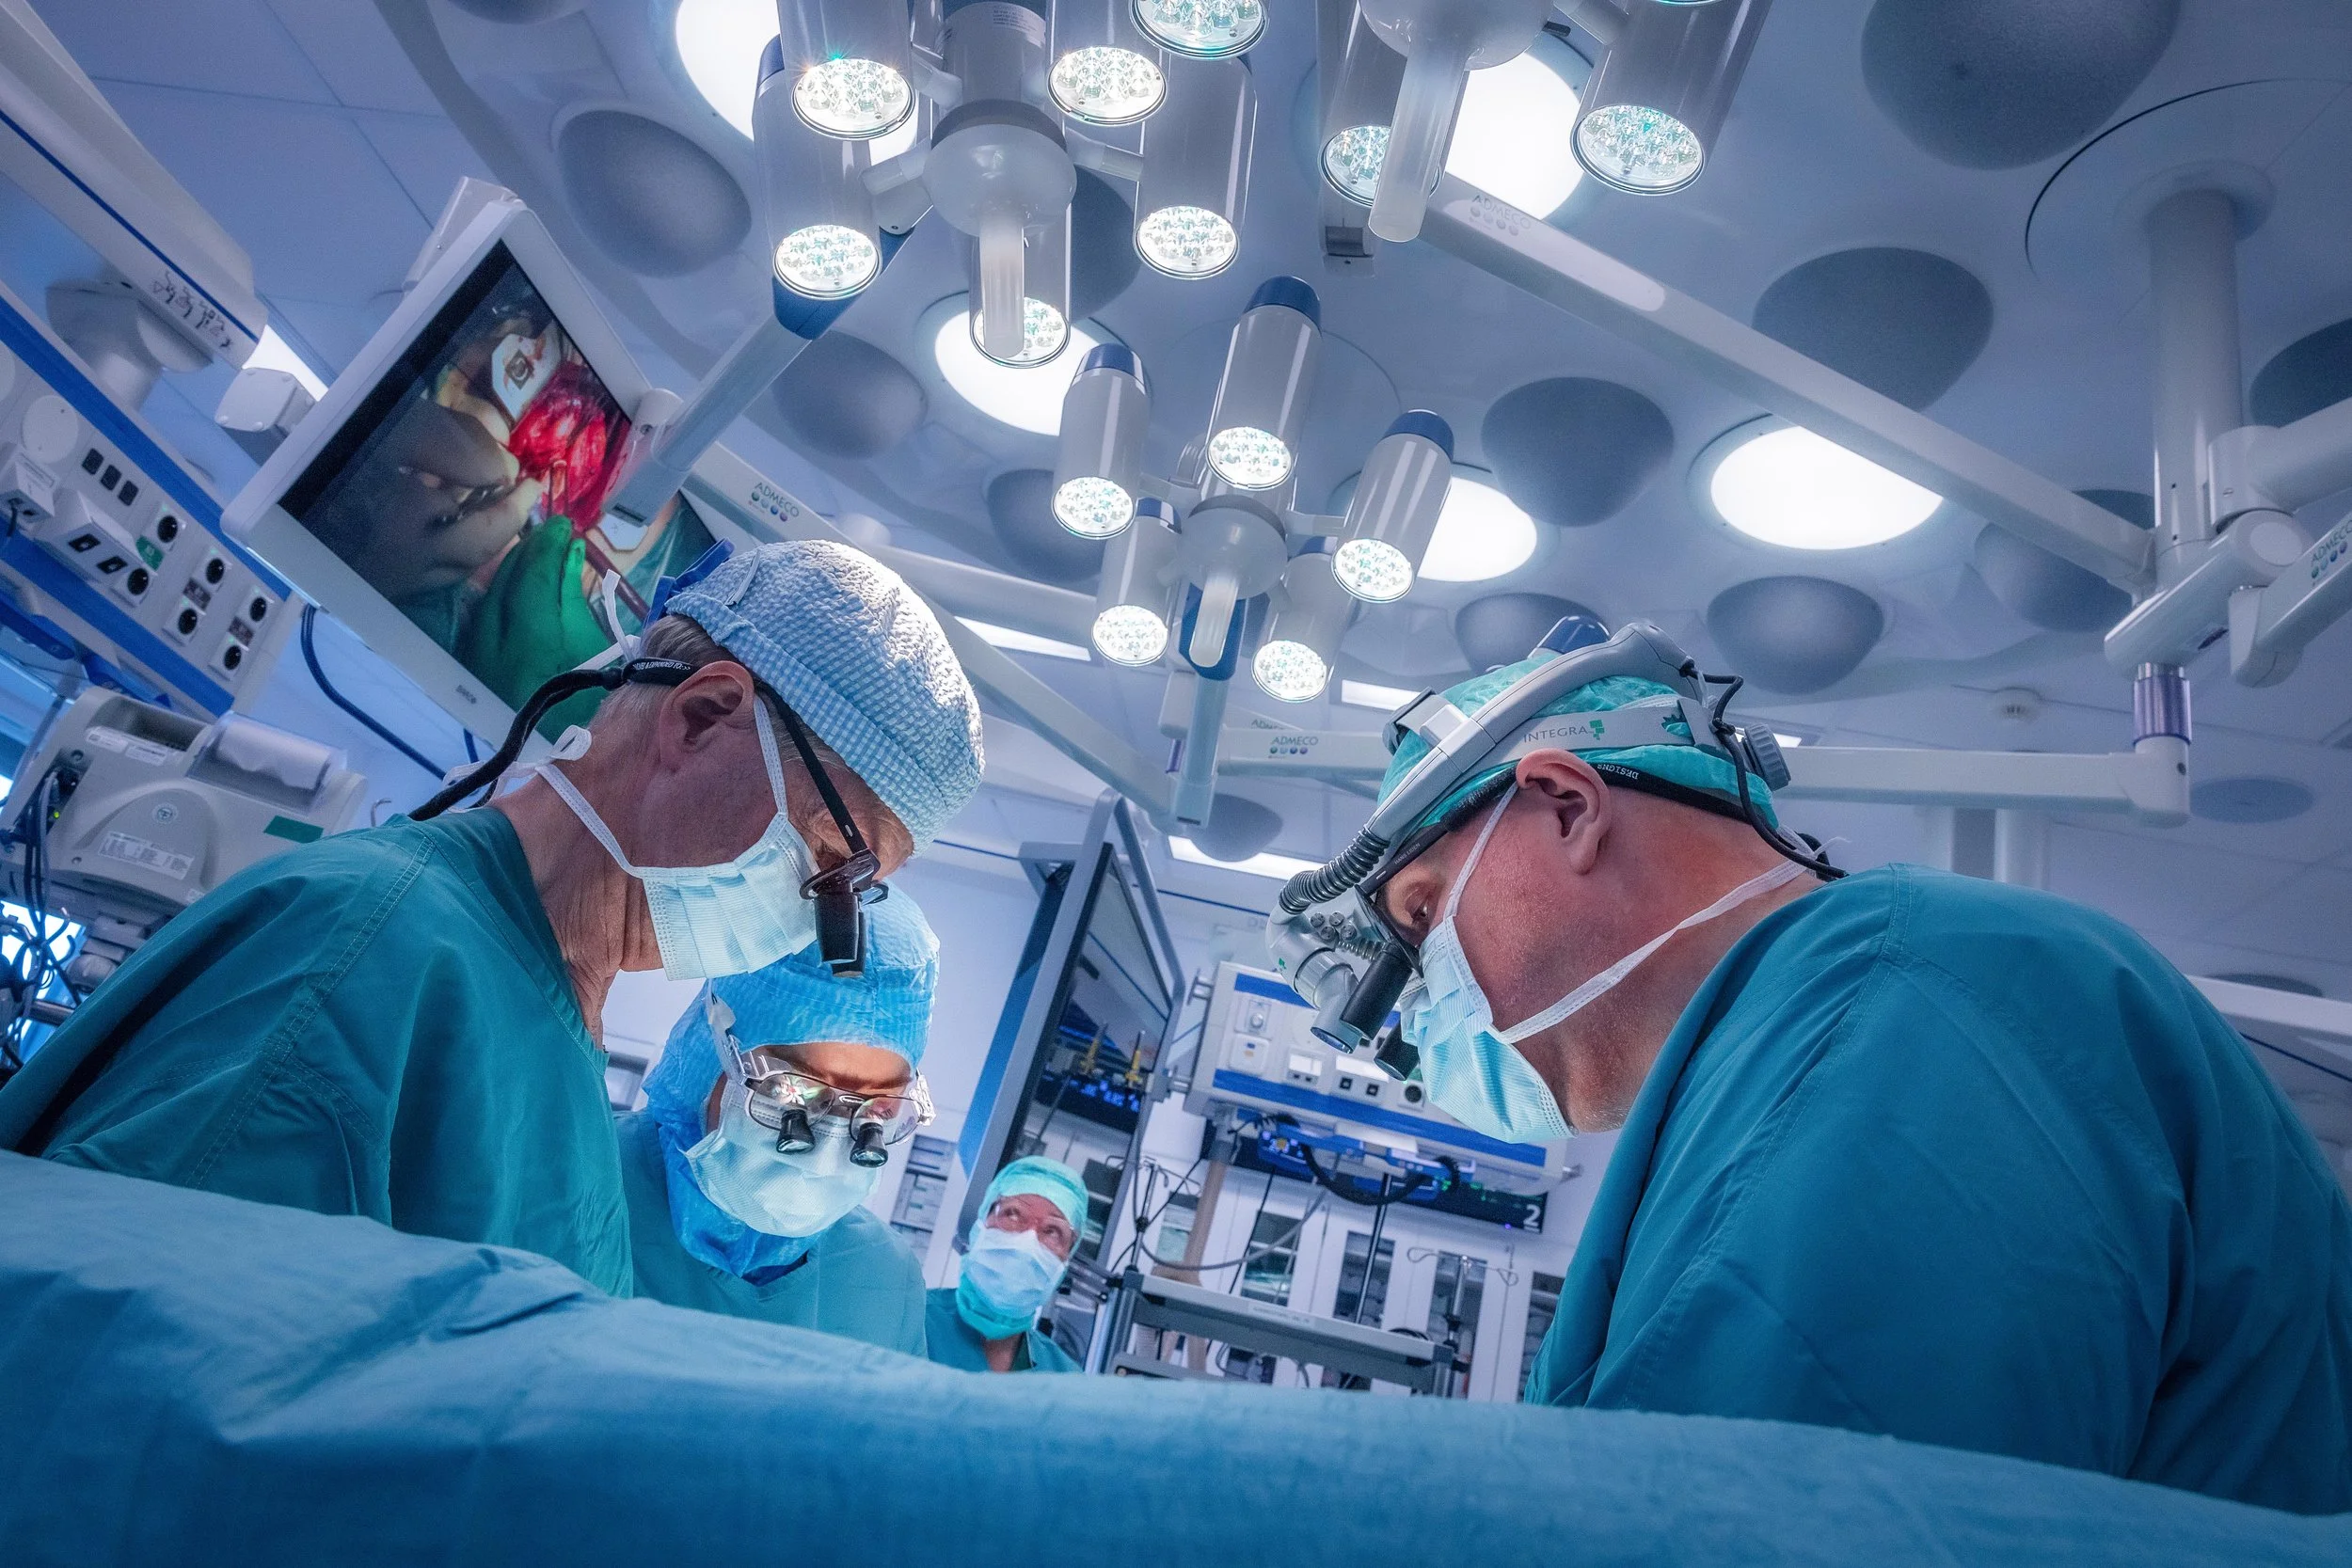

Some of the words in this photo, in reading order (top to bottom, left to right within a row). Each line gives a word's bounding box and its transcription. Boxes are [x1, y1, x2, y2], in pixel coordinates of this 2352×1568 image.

[1472, 195, 1531, 230] ADMECO
[755, 482, 800, 517] ADMECO
[1271, 736, 1319, 746] ADMECO
[1523, 725, 1588, 743] INTEGRA
[1597, 763, 1639, 780] DESIGNS
[1523, 1204, 1541, 1227] 2
